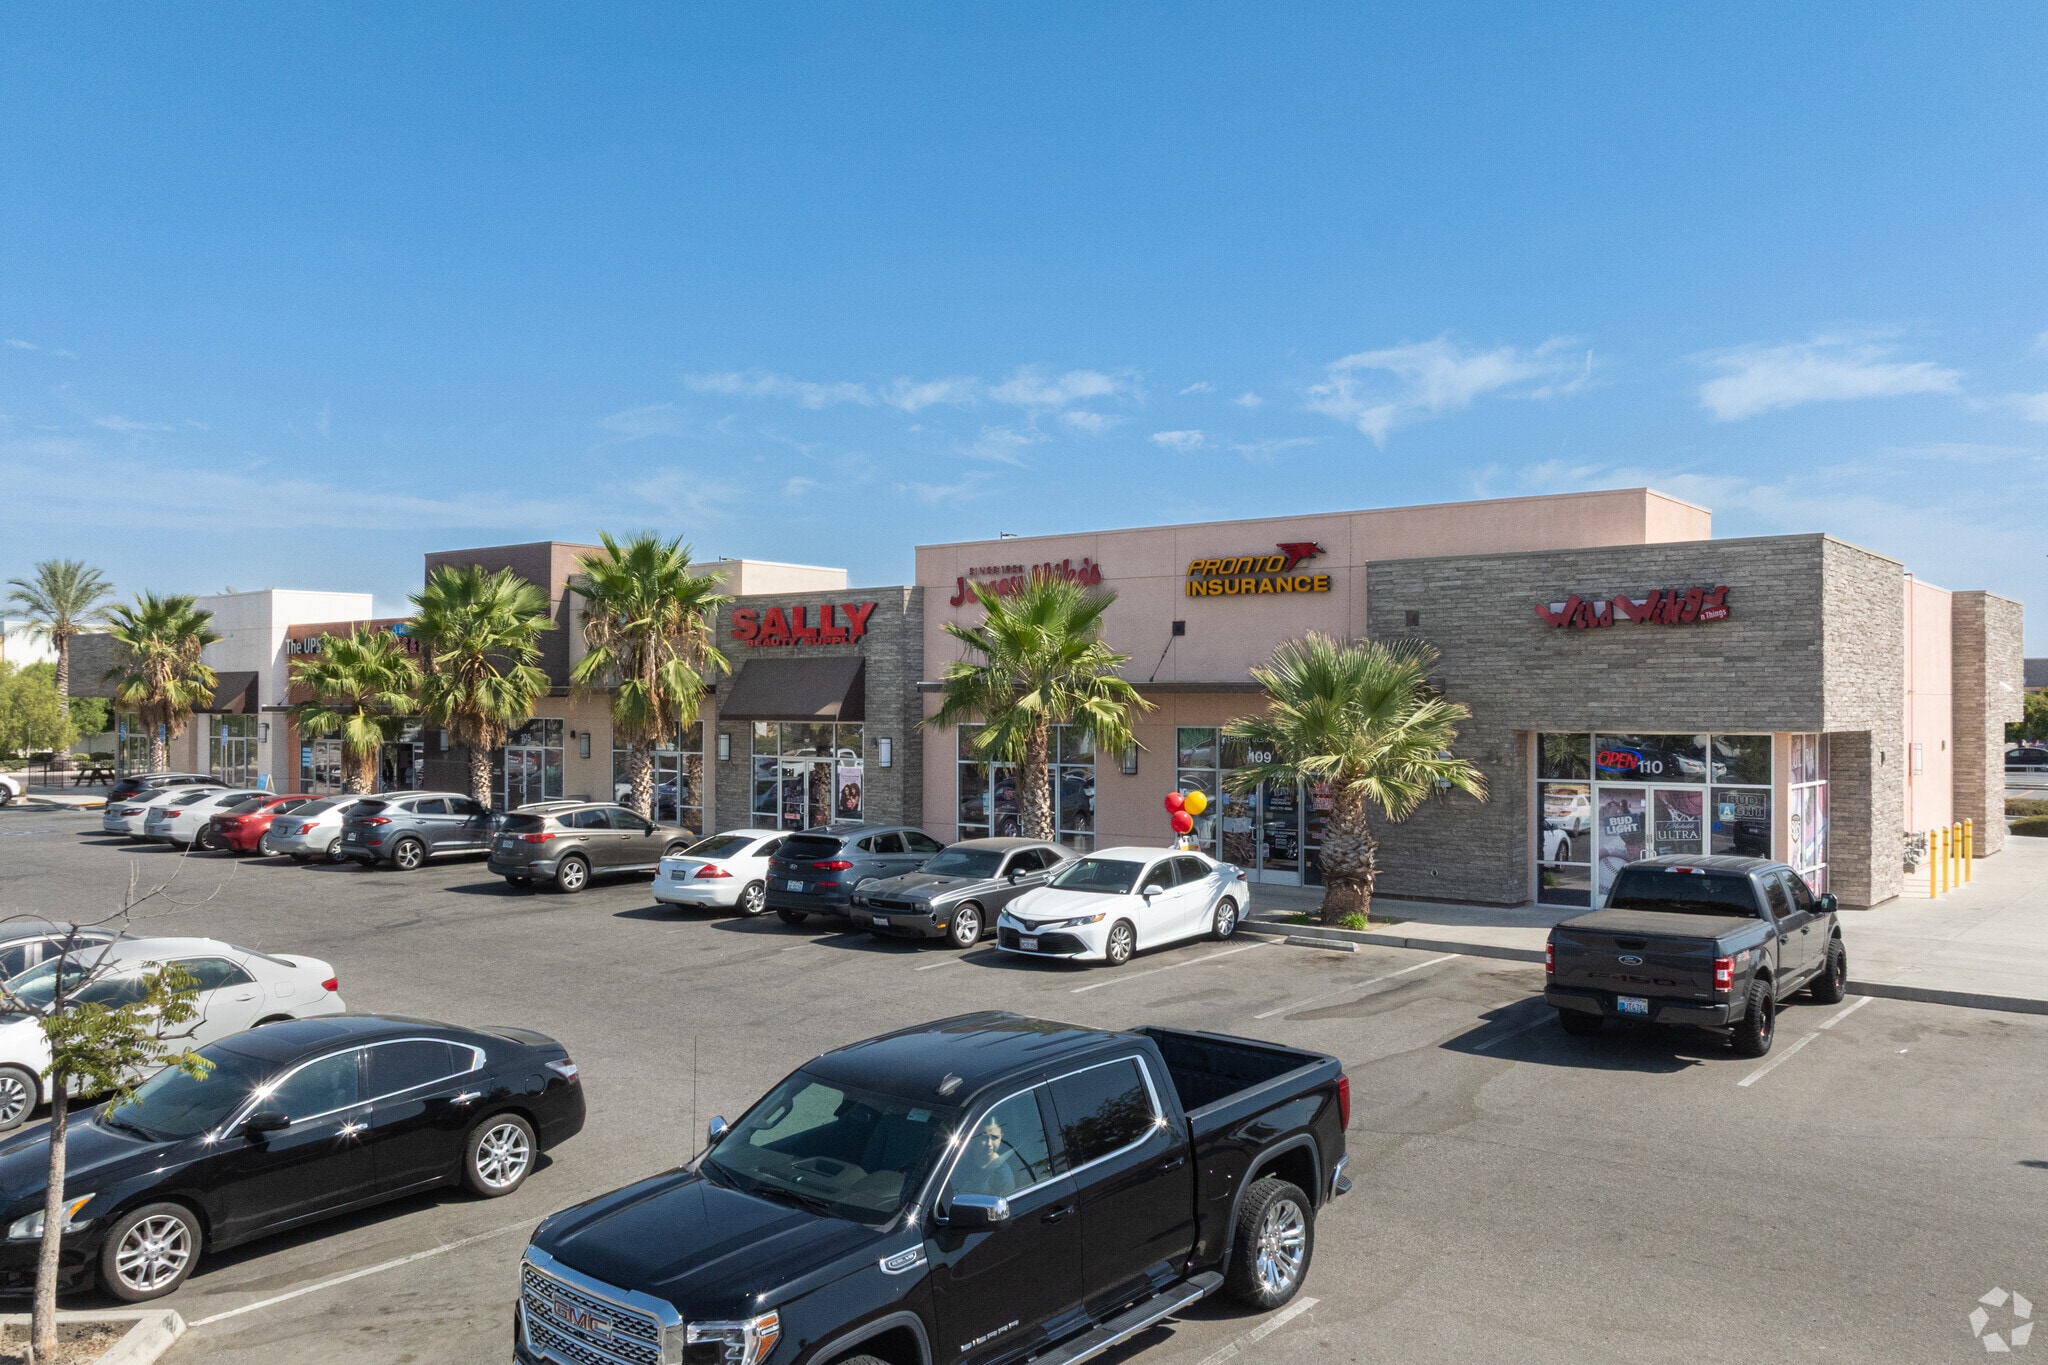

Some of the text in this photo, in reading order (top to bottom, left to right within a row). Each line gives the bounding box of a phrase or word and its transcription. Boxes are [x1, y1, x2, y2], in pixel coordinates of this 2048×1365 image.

[969, 564, 1024, 577] SINCE 1956
[1186, 555, 1286, 577] PRONTO
[1185, 575, 1330, 597] INSURANCE
[731, 602, 878, 641] SALLY
[1705, 609, 1727, 620] Things
[285, 637, 322, 654] The UPS
[746, 634, 860, 648] BEAUTY SUPPLY
[1250, 751, 1272, 763] 109
[1597, 749, 1639, 770] OPEN
[1637, 760, 1663, 774] 110
[1724, 806, 1731, 816] A
[1609, 815, 1632, 826] BUD
[1606, 823, 1638, 835] LIGHT
[1658, 830, 1699, 839] ULTRA
[554, 1300, 612, 1338] GMC
